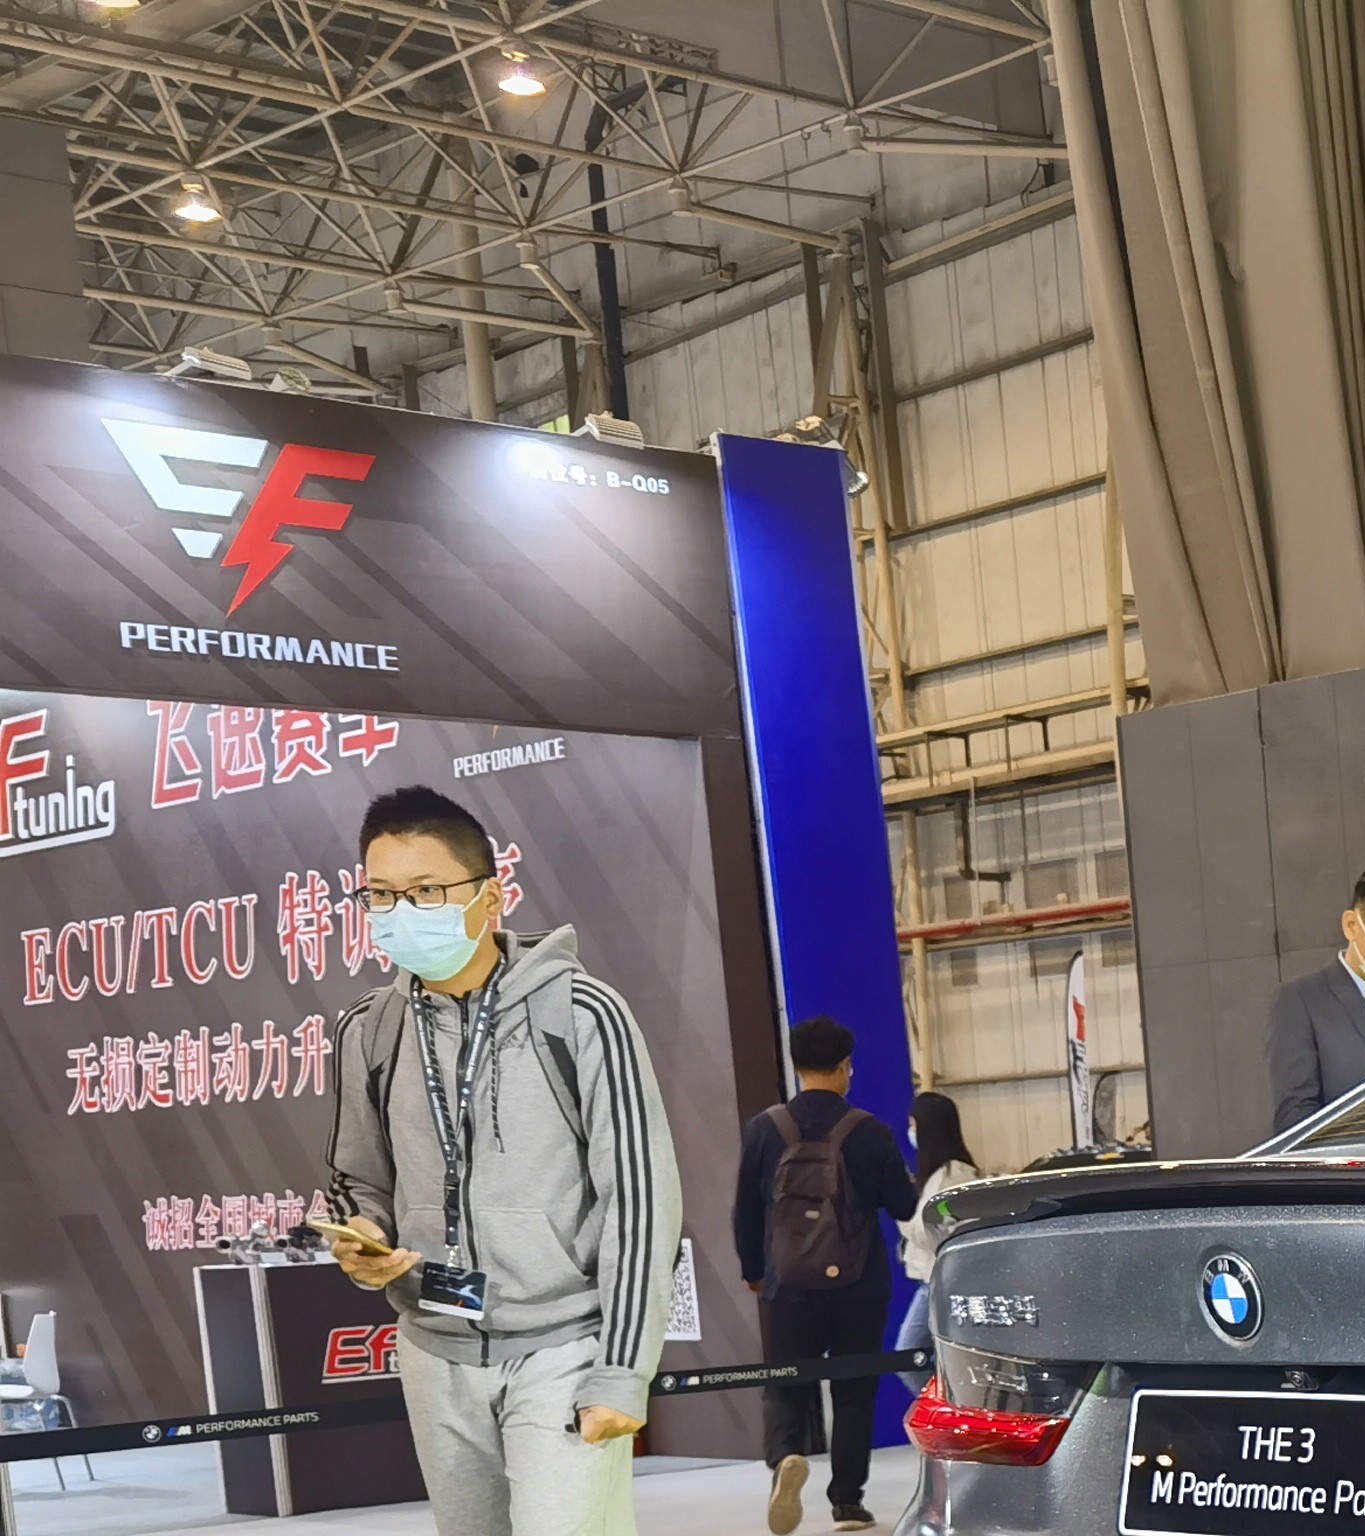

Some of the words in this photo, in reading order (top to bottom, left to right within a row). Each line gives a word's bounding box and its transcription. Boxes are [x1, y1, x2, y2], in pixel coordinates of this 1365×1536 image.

[119, 621, 400, 672] PERFORMANCE
[453, 737, 566, 778] PERFORMANCE
[13, 754, 116, 840] tuning
[21, 893, 258, 1006] ECU/TCU
[66, 1014, 335, 1115] 无损定制动力升
[702, 1369, 769, 1384] PERFORMANCE
[770, 1366, 799, 1378] PARTS
[196, 1416, 282, 1434] PERFORMANCE
[283, 1412, 320, 1425] PARTS
[1238, 1425, 1294, 1463] THE
[1297, 1428, 1316, 1464] 3
[1150, 1470, 1175, 1505] M
[1177, 1471, 1327, 1514] Performance
